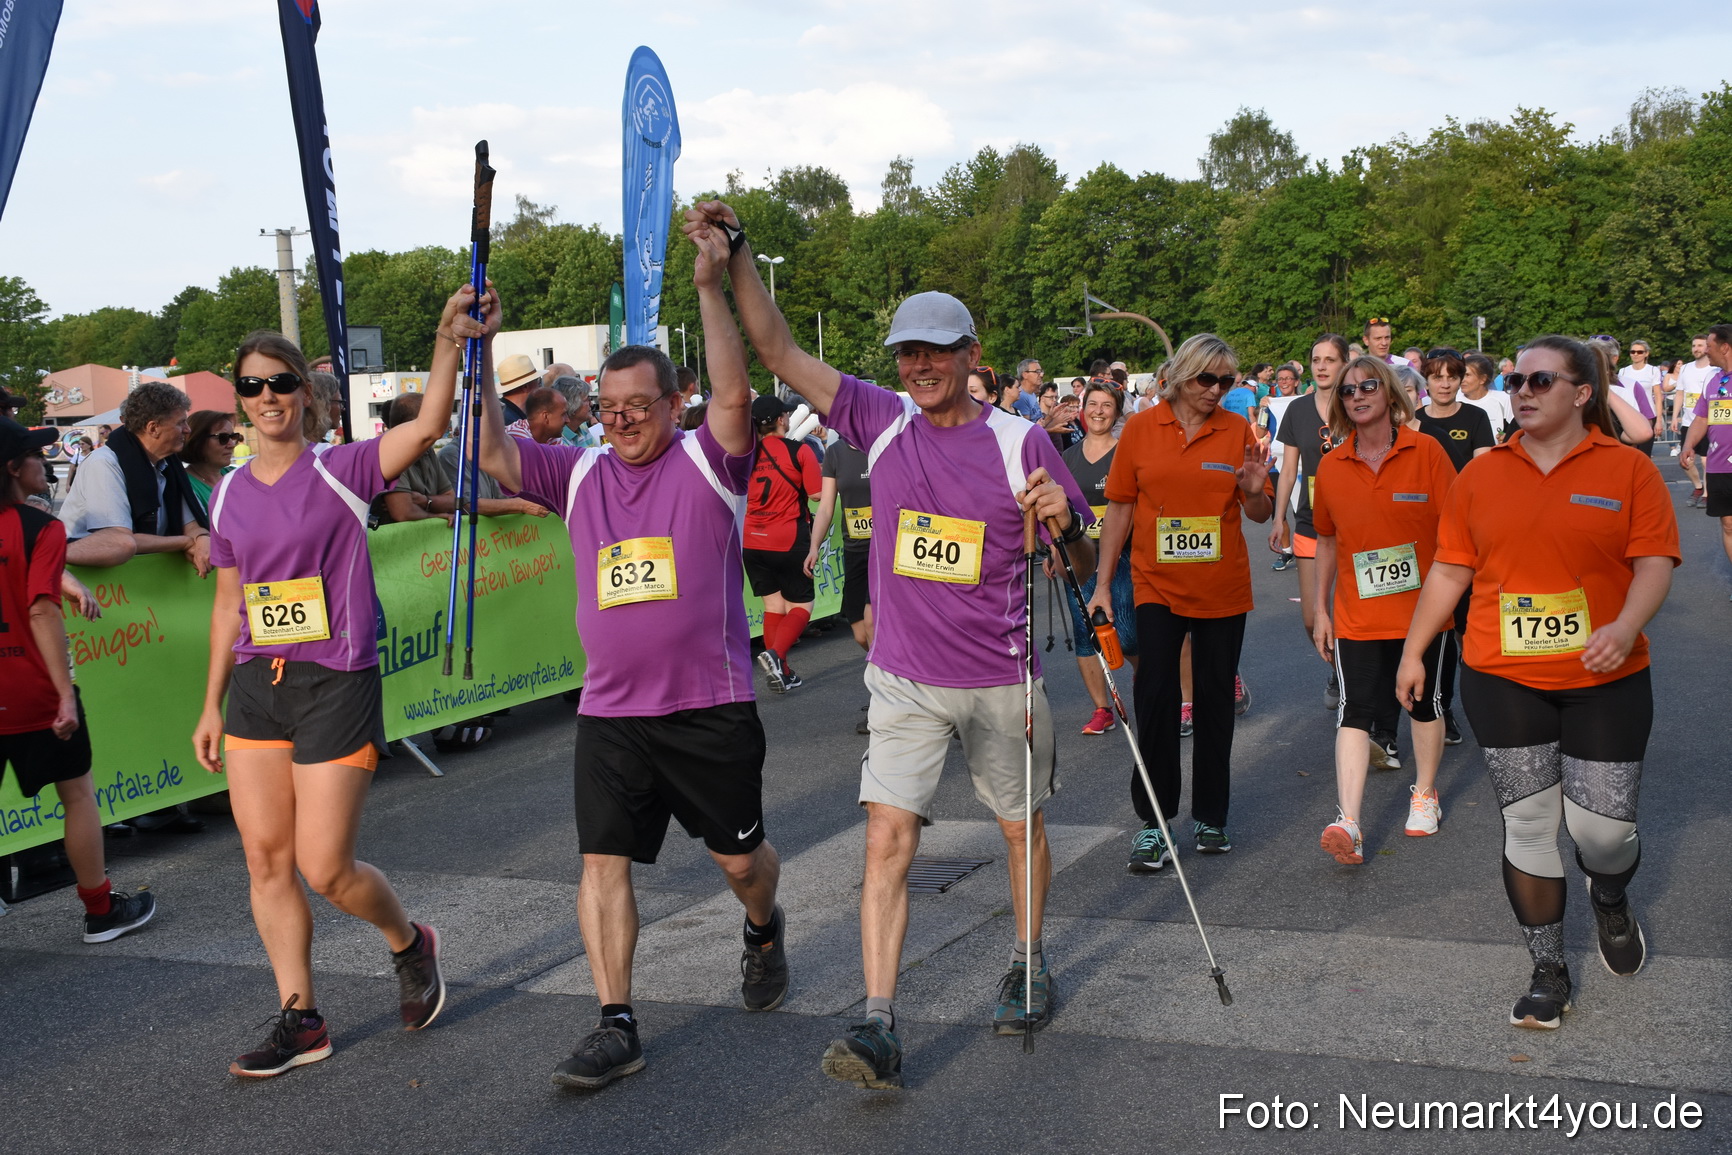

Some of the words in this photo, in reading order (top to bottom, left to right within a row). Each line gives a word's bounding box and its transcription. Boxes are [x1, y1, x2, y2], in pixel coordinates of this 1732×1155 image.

[756, 476, 772, 506] 7
[490, 523, 540, 553] Firmen
[913, 537, 960, 564] 640
[1165, 533, 1212, 550] 1804
[460, 566, 509, 602] lufen
[509, 542, 560, 585] länger!
[611, 560, 656, 588] 632
[916, 560, 934, 569] Meier
[935, 563, 955, 571] Erwin
[1365, 561, 1411, 584] 1799
[262, 602, 306, 627] 626
[1512, 613, 1579, 638] 1795
[70, 606, 164, 666] änger!
[377, 610, 442, 674] nlauf
[404, 656, 574, 720] www.firmenlauf-oberpfalz.de
